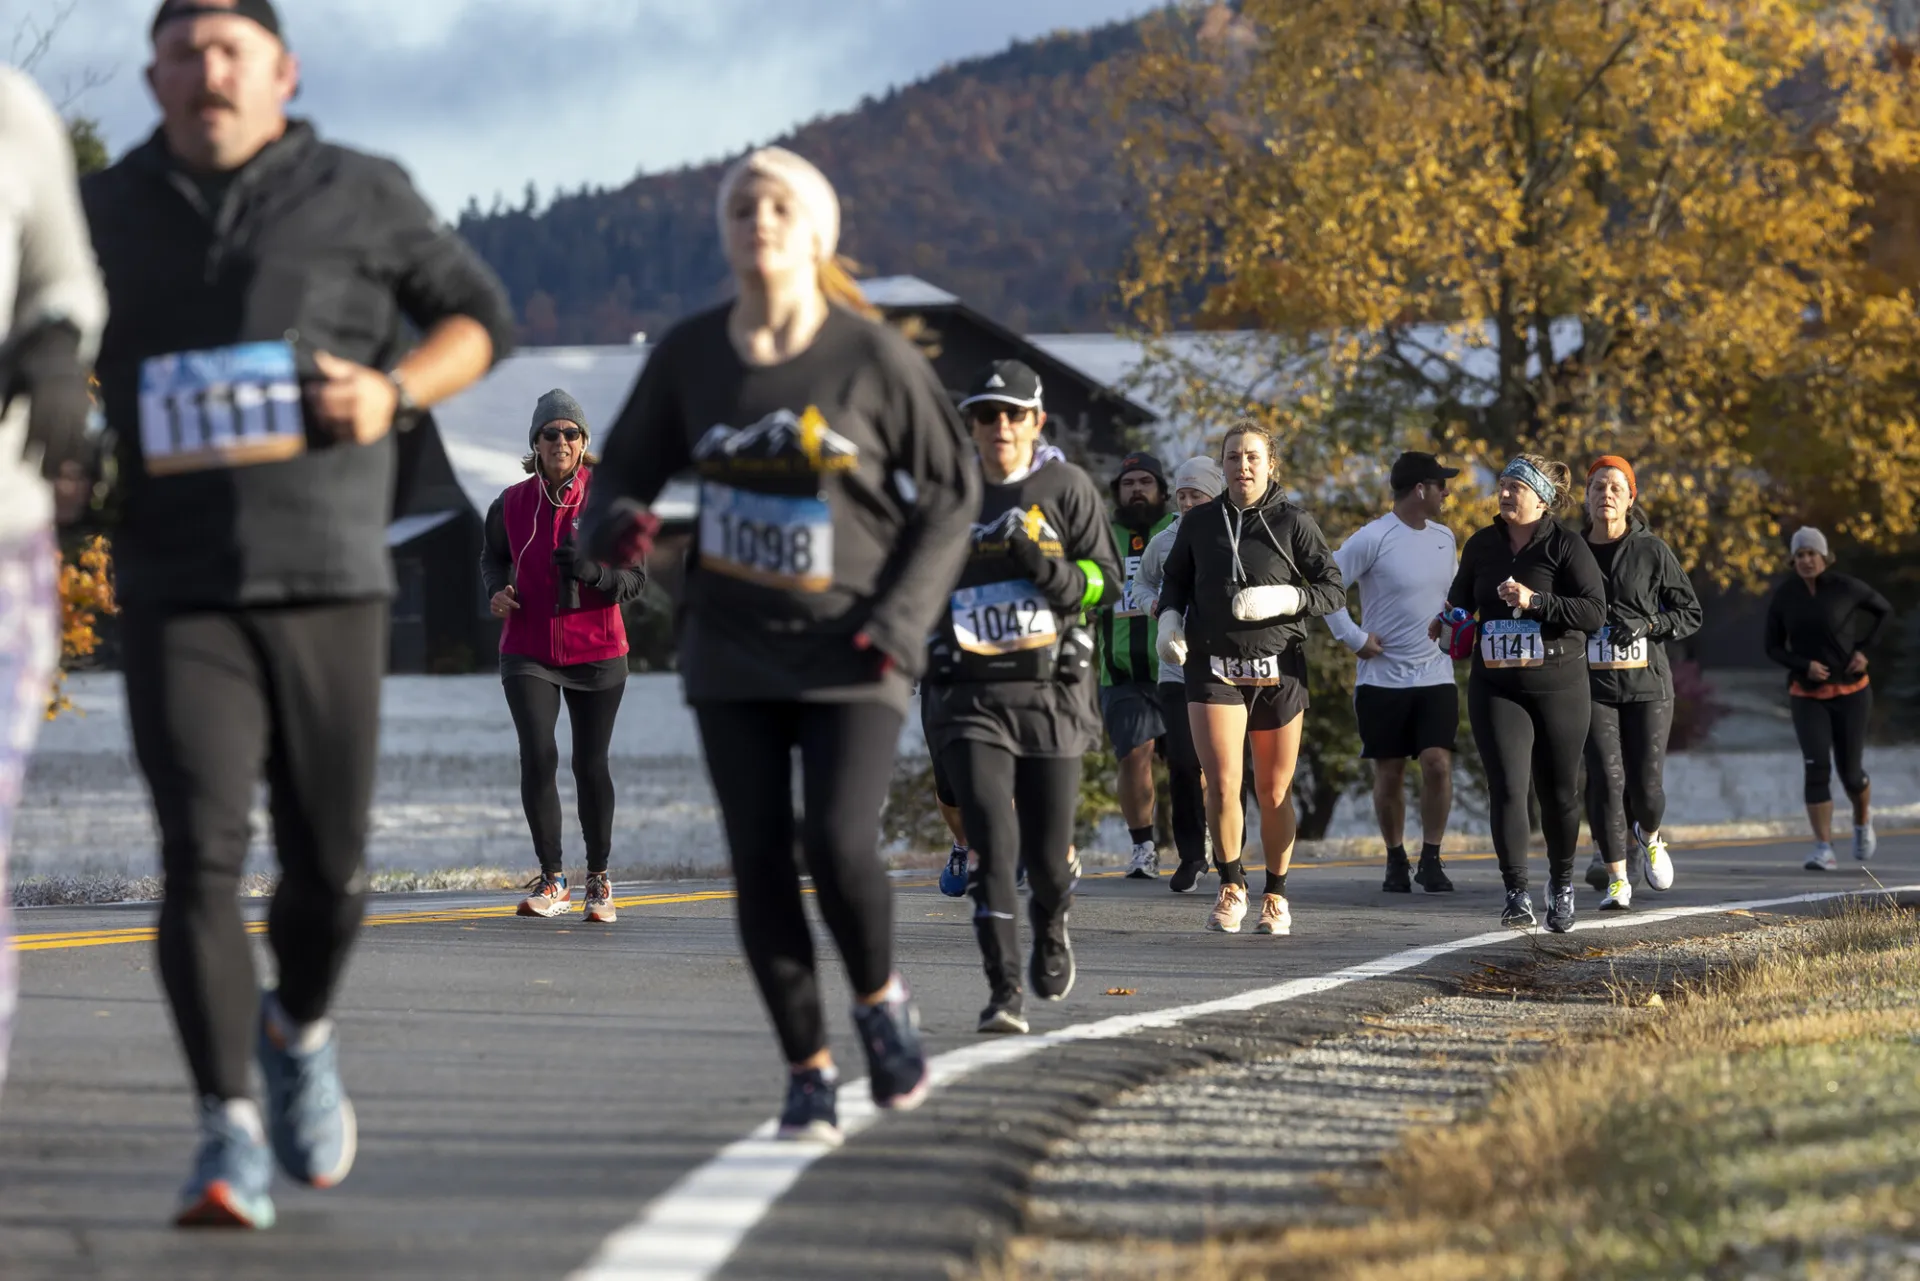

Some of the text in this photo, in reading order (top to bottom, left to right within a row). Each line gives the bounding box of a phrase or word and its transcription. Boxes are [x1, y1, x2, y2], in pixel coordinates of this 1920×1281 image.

[717, 512, 813, 574] 1098
[966, 598, 1043, 642] 1042
[1487, 633, 1535, 660] 1141
[1595, 640, 1641, 662] 1196
[1218, 656, 1272, 679] 1315
